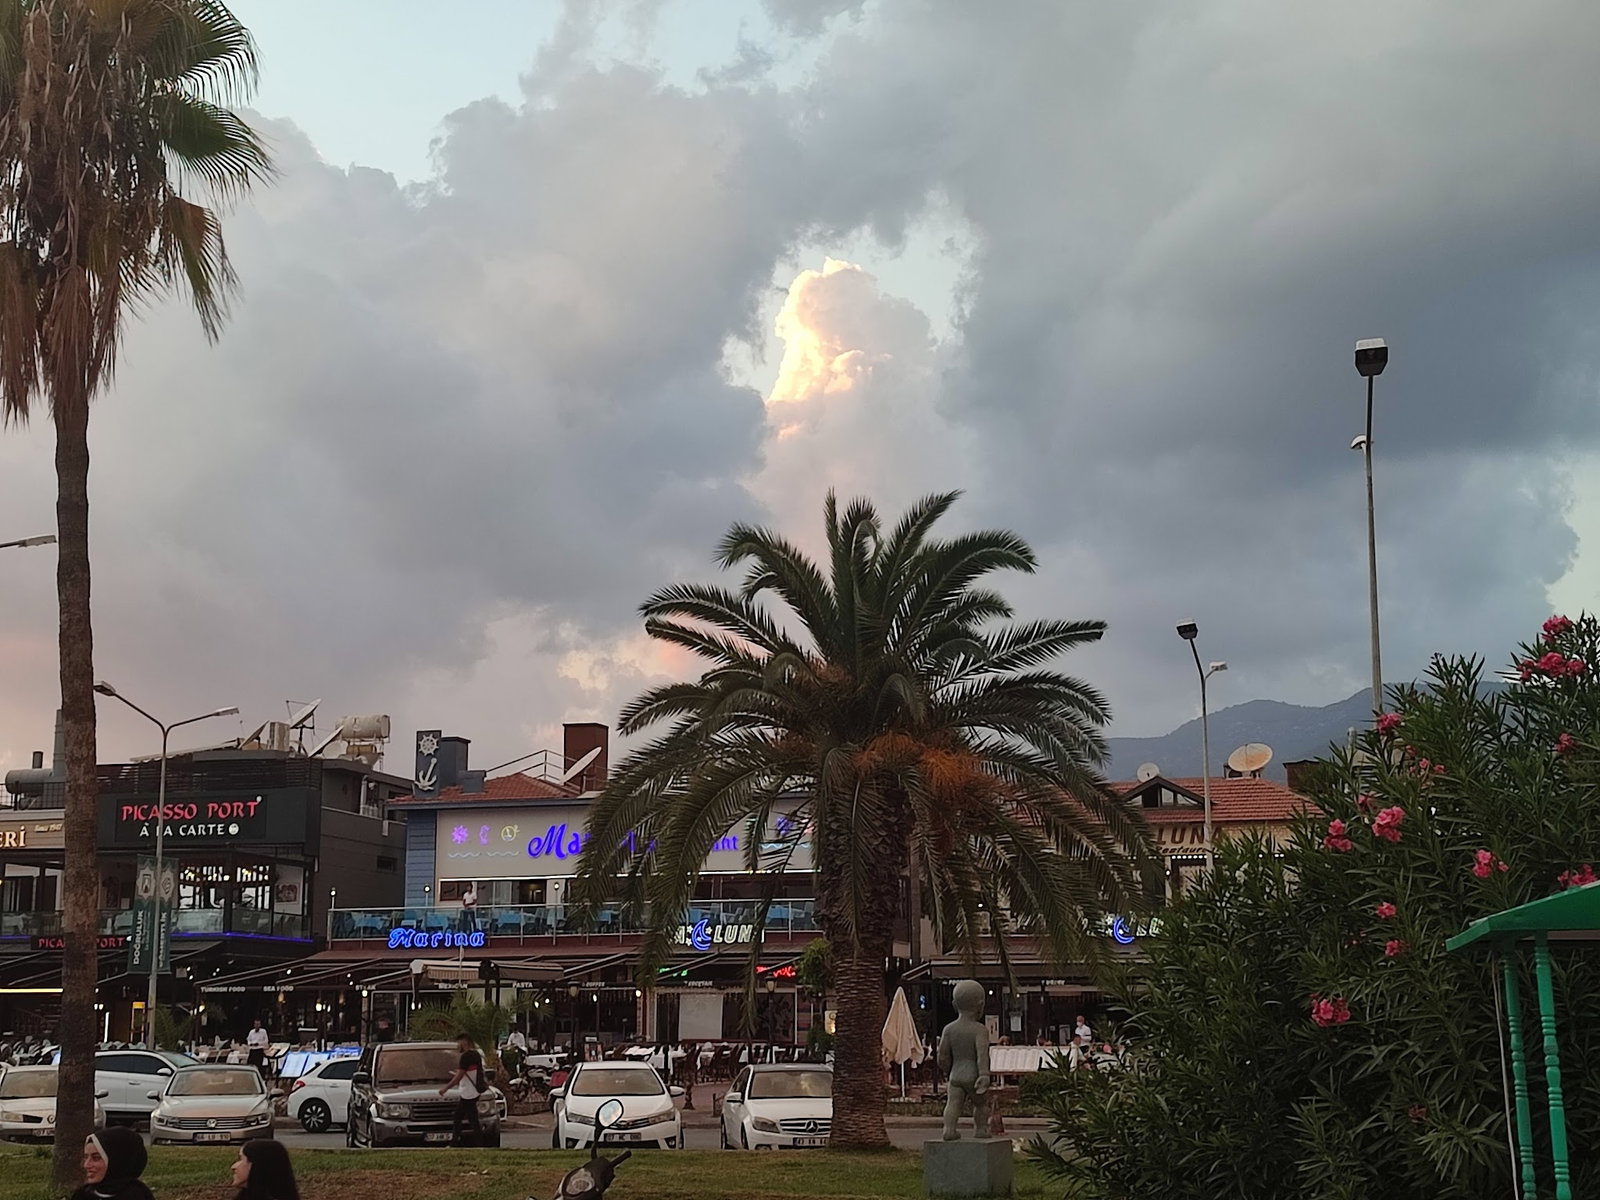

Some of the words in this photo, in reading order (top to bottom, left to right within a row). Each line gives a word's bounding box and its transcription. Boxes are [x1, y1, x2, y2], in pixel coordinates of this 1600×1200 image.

[122, 804, 197, 821] PICASSO
[207, 801, 258, 818] PORT
[0, 825, 26, 848] Rİ
[179, 823, 225, 836] CARTE
[38, 938, 65, 948] PICA
[97, 937, 124, 948] ORT
[388, 928, 485, 949] Marina
[713, 924, 764, 944] LUN
